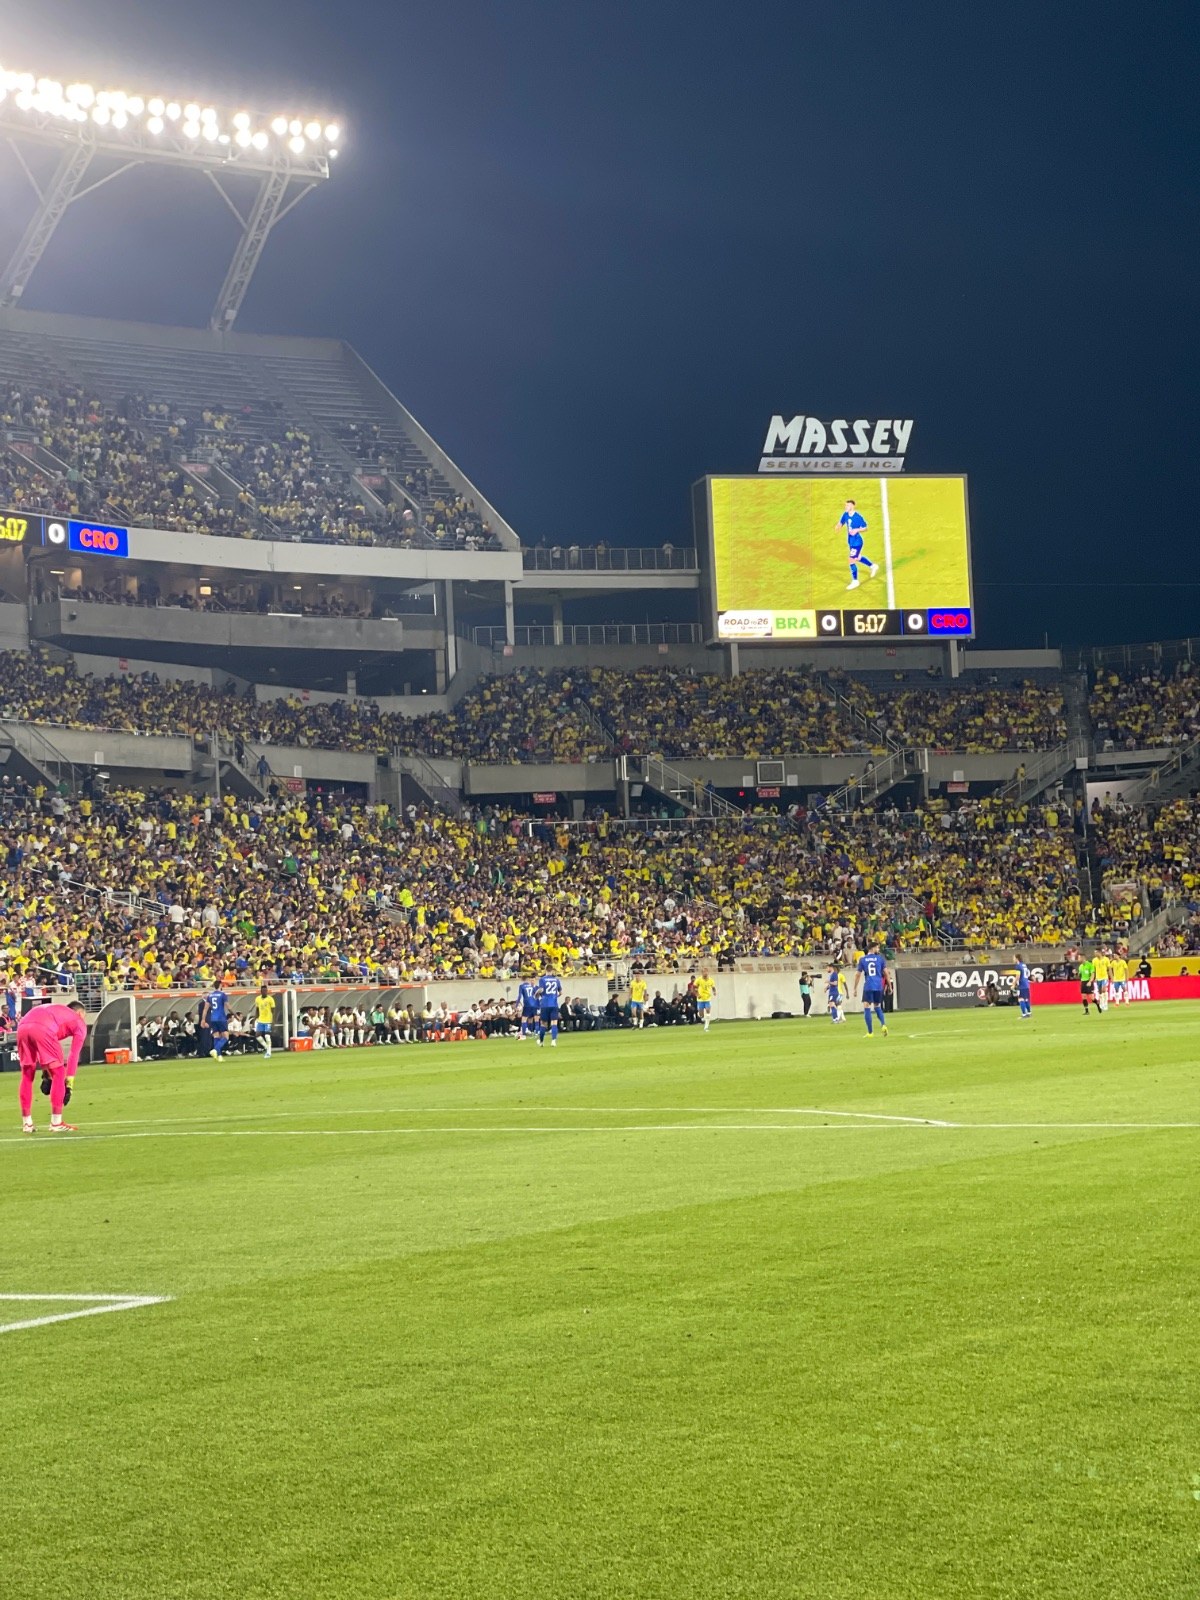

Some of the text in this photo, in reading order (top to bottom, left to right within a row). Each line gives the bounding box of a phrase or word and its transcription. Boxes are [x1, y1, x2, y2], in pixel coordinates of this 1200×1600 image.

[762, 415, 914, 454] MASSEY
[766, 460, 897, 469] SERVICES INC.
[48, 523, 65, 544] 0
[79, 528, 119, 551] CRO
[776, 615, 836, 631] BRA 0
[854, 614, 886, 633] 6:07
[908, 614, 968, 630] 0 CRO
[868, 962, 876, 976] 6
[936, 970, 1016, 988] ROAD TO
[525, 987, 533, 997] 17
[545, 982, 557, 994] 22
[211, 997, 218, 1009] 5
